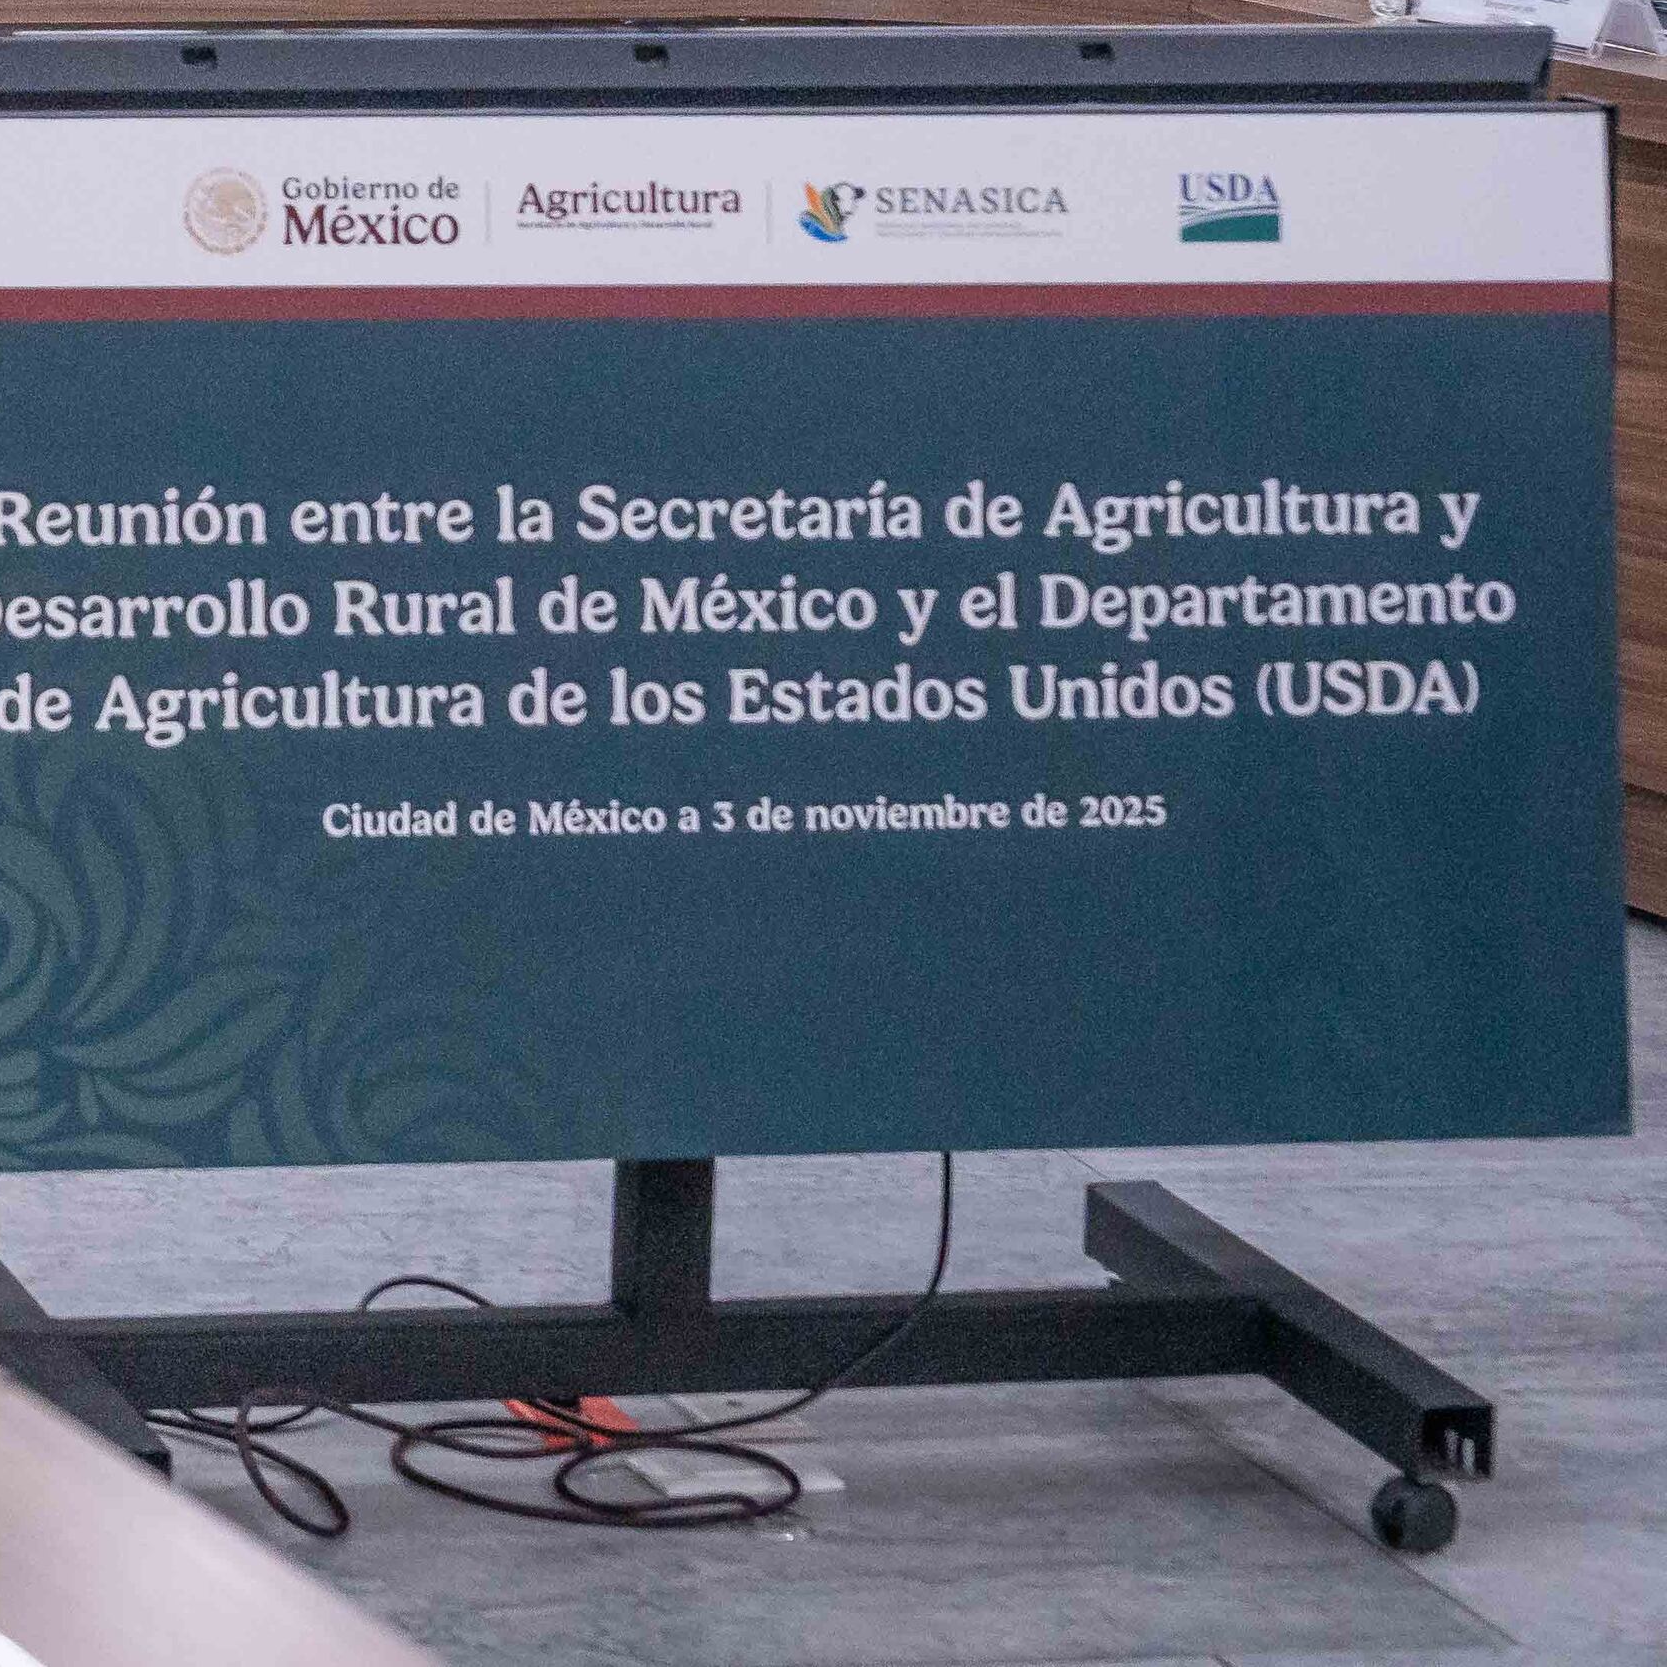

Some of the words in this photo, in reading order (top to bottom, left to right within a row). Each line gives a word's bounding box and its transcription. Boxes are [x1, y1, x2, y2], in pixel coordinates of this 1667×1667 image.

[282, 176, 419, 200] Gobierno
[428, 176, 458, 199] de
[519, 181, 740, 218] Agricultura
[876, 187, 1068, 214] SENASICA
[1180, 174, 1278, 203] USDA
[284, 204, 458, 245] México
[291, 492, 474, 544] entre
[497, 484, 553, 543] la
[577, 480, 922, 542] Secretaría
[945, 480, 1022, 538] de
[1043, 478, 1419, 551] Agricultura
[1439, 493, 1480, 548] y
[334, 576, 515, 636] Rural
[539, 575, 618, 634] de
[640, 573, 877, 633] México
[897, 589, 939, 641] y
[960, 571, 1017, 629] el
[1039, 574, 1515, 640] Departamento
[94, 670, 484, 744] Agricultura
[508, 667, 587, 727] de
[610, 667, 705, 725] los
[728, 663, 988, 723] Estados
[1009, 660, 1234, 720] Unidos
[1257, 660, 1478, 716] (USDA)
[323, 801, 457, 838] Ciudad
[469, 800, 516, 836] de
[528, 799, 667, 835] México
[678, 806, 700, 833] a
[713, 801, 735, 832] 3
[746, 796, 793, 832] de
[805, 794, 1010, 831] noviembre
[1021, 793, 1068, 828] de
[1080, 795, 1167, 827] 2025
